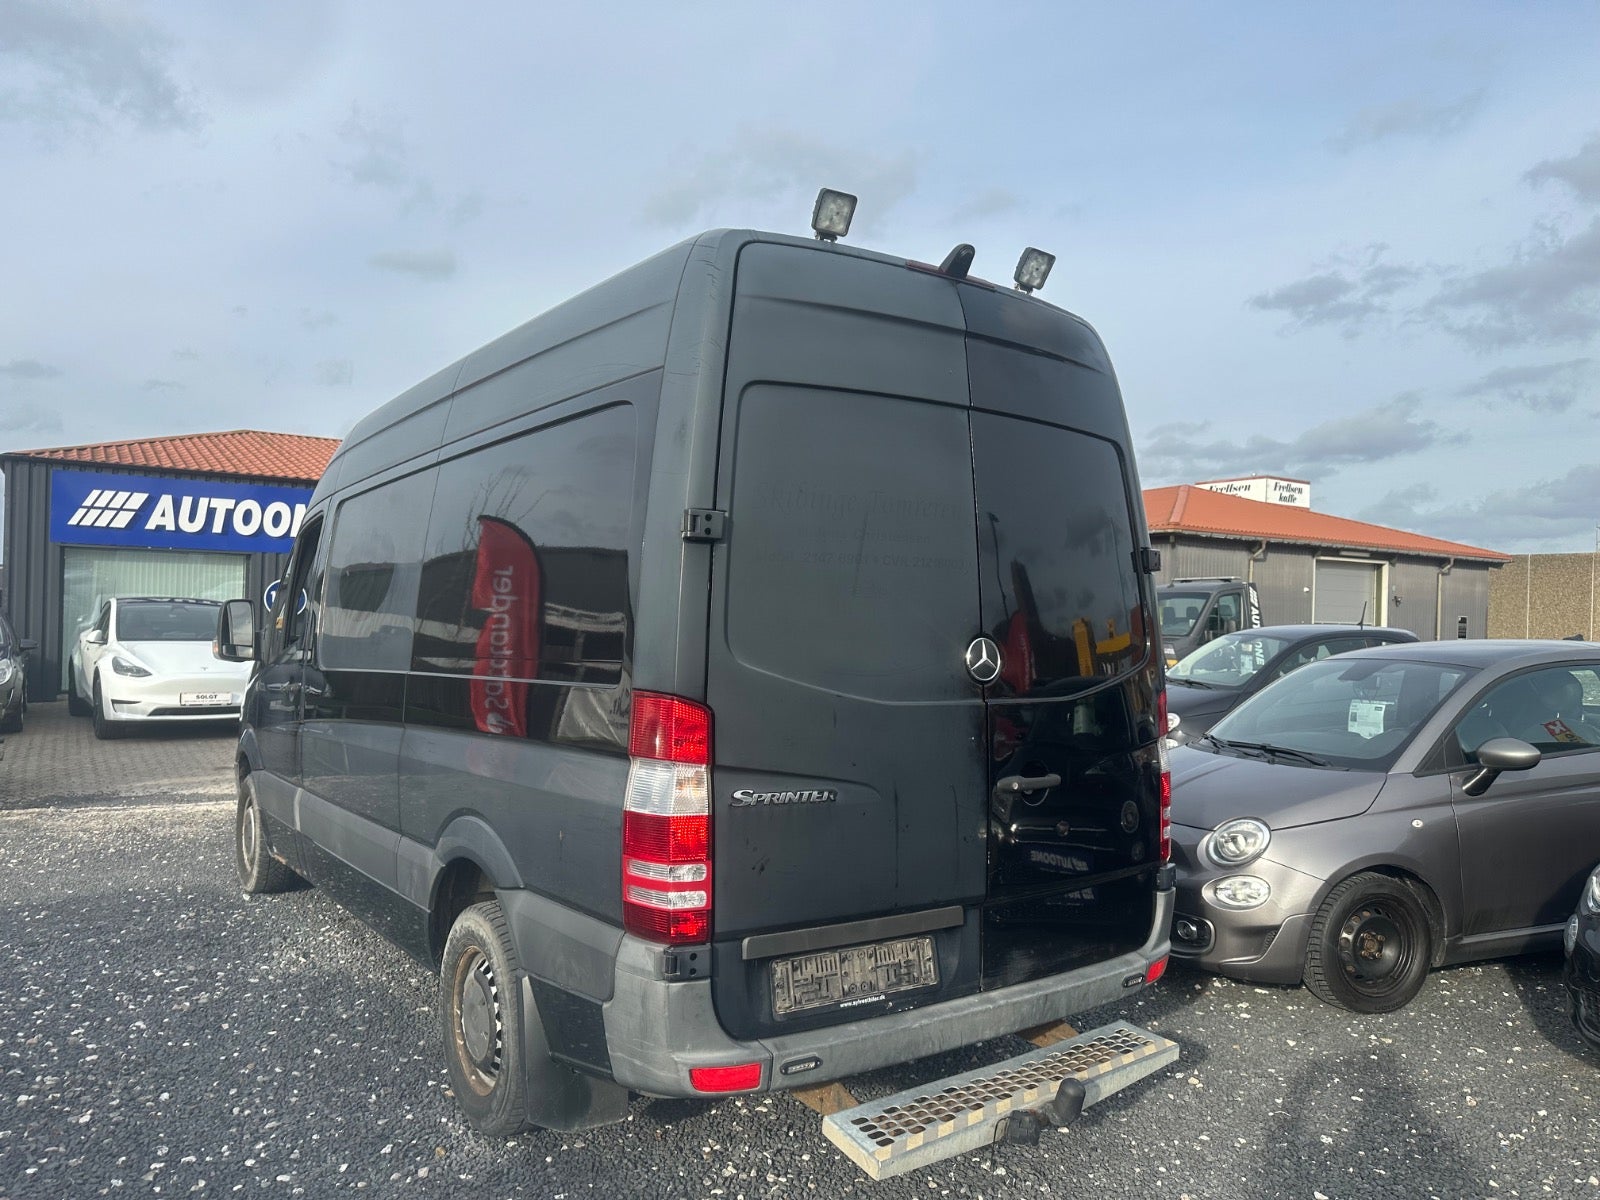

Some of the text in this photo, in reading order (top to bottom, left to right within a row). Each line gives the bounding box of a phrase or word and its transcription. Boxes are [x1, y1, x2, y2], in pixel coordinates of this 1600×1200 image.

[1273, 481, 1304, 495] Frellsen
[1278, 492, 1298, 504] kaffe
[731, 789, 836, 807] SPRINTER
